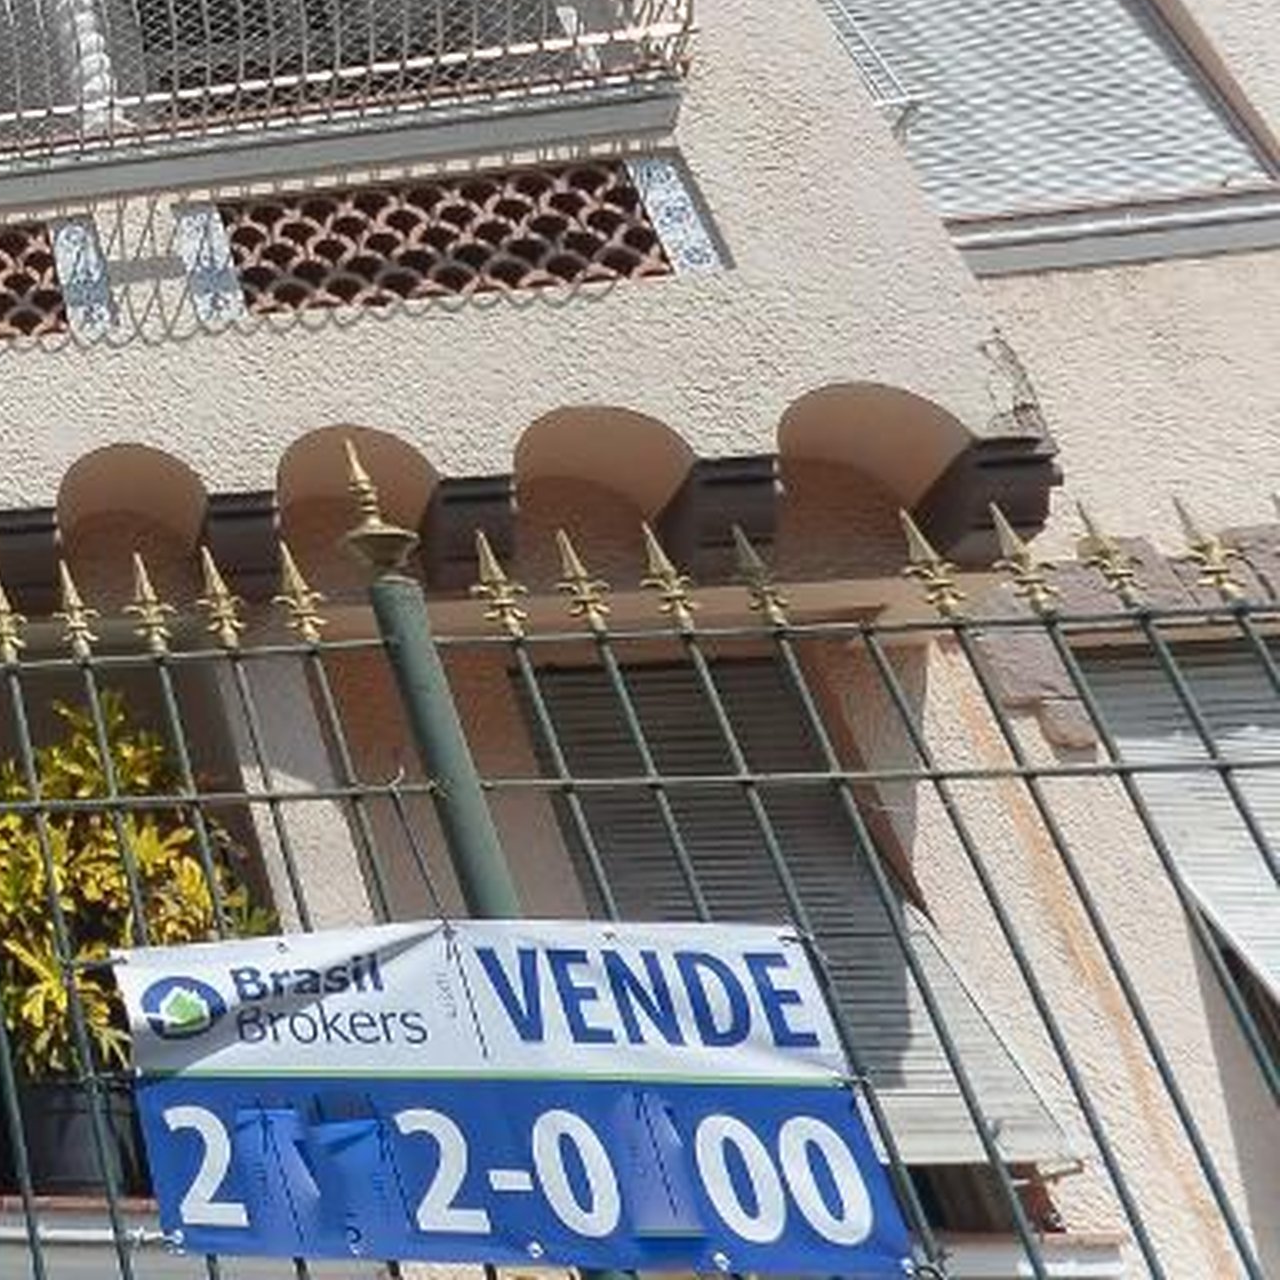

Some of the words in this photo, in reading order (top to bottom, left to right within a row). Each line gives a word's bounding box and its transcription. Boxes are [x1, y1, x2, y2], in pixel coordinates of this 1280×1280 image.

[230, 951, 384, 998] Brasil
[475, 946, 821, 1049] VENDE
[238, 1003, 428, 1047] Brokers
